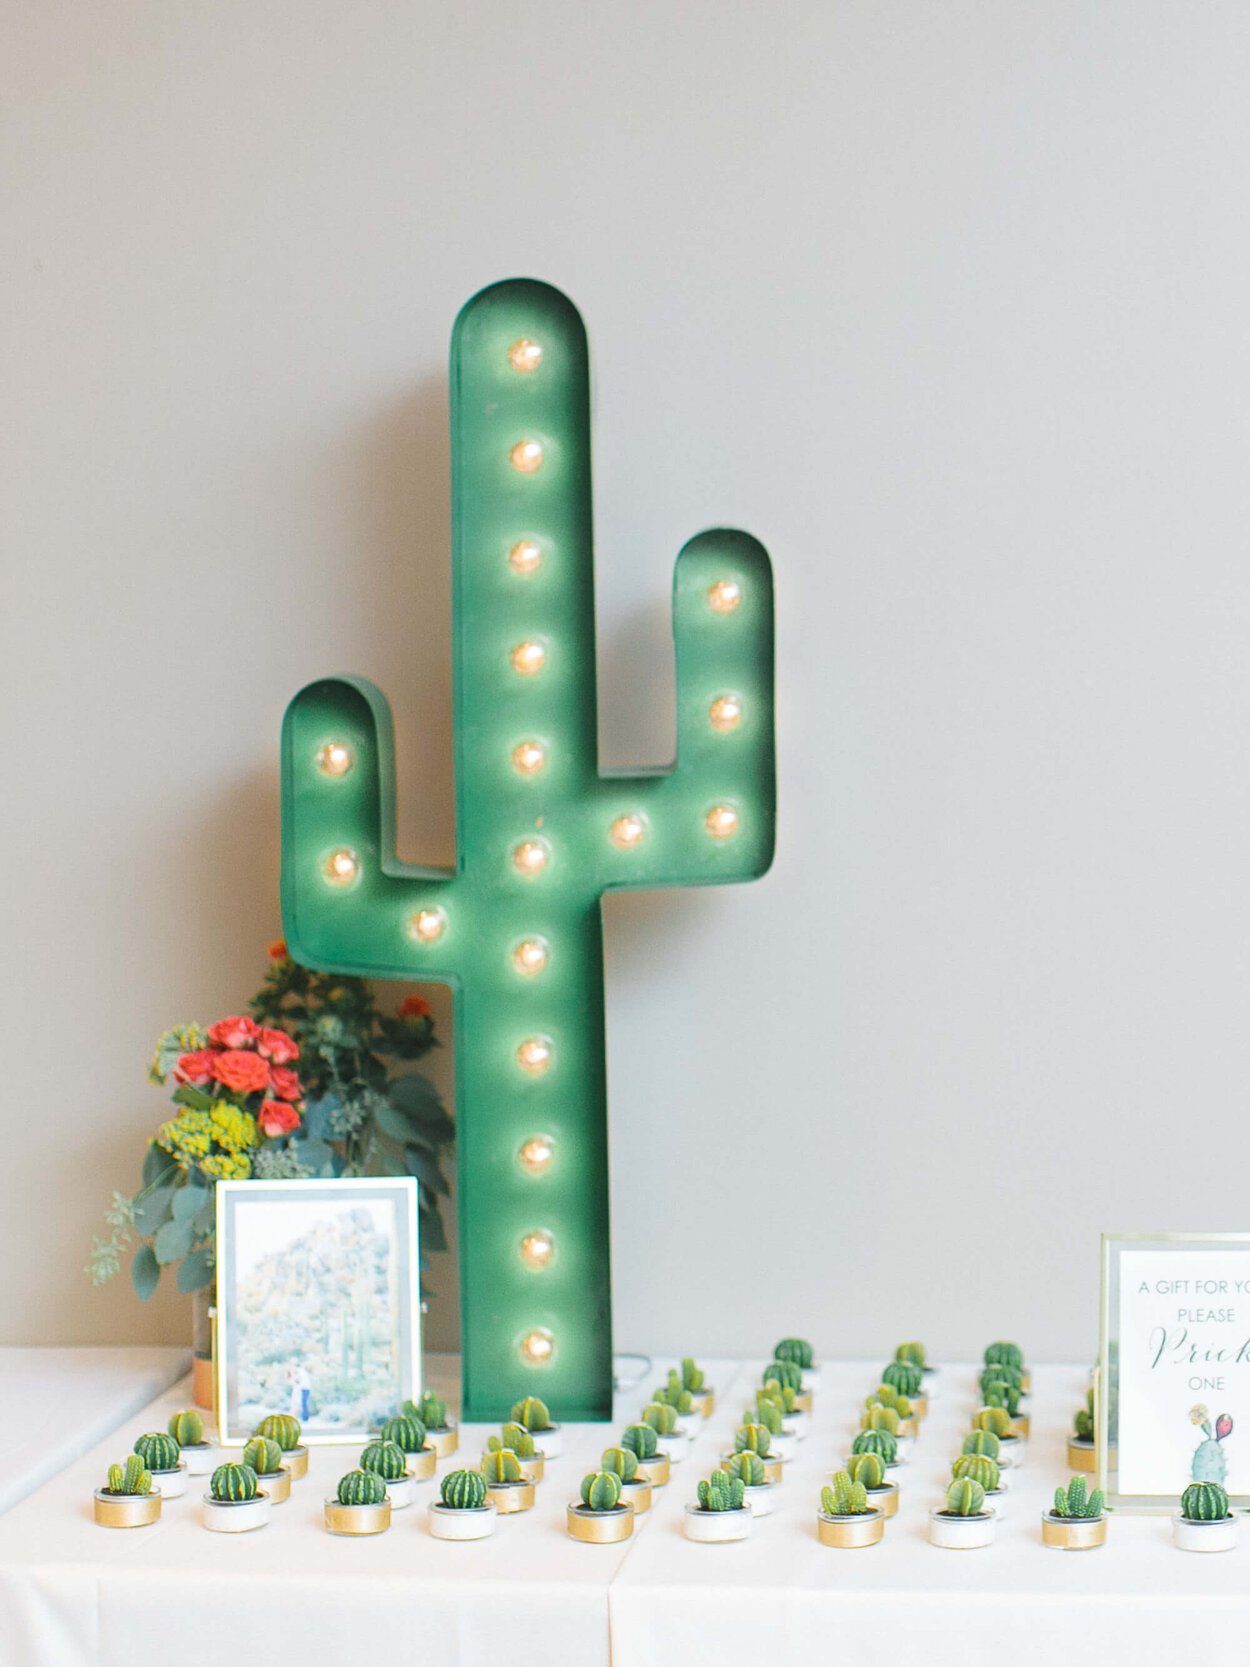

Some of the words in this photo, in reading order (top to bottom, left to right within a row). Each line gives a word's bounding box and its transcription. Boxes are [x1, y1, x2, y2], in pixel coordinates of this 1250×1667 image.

[1138, 1281, 1150, 1294] A
[1155, 1280, 1190, 1294] GIFT
[1195, 1280, 1228, 1294] FOR
[1178, 1308, 1235, 1322] PLEASE
[1188, 1376, 1224, 1390] ONE
